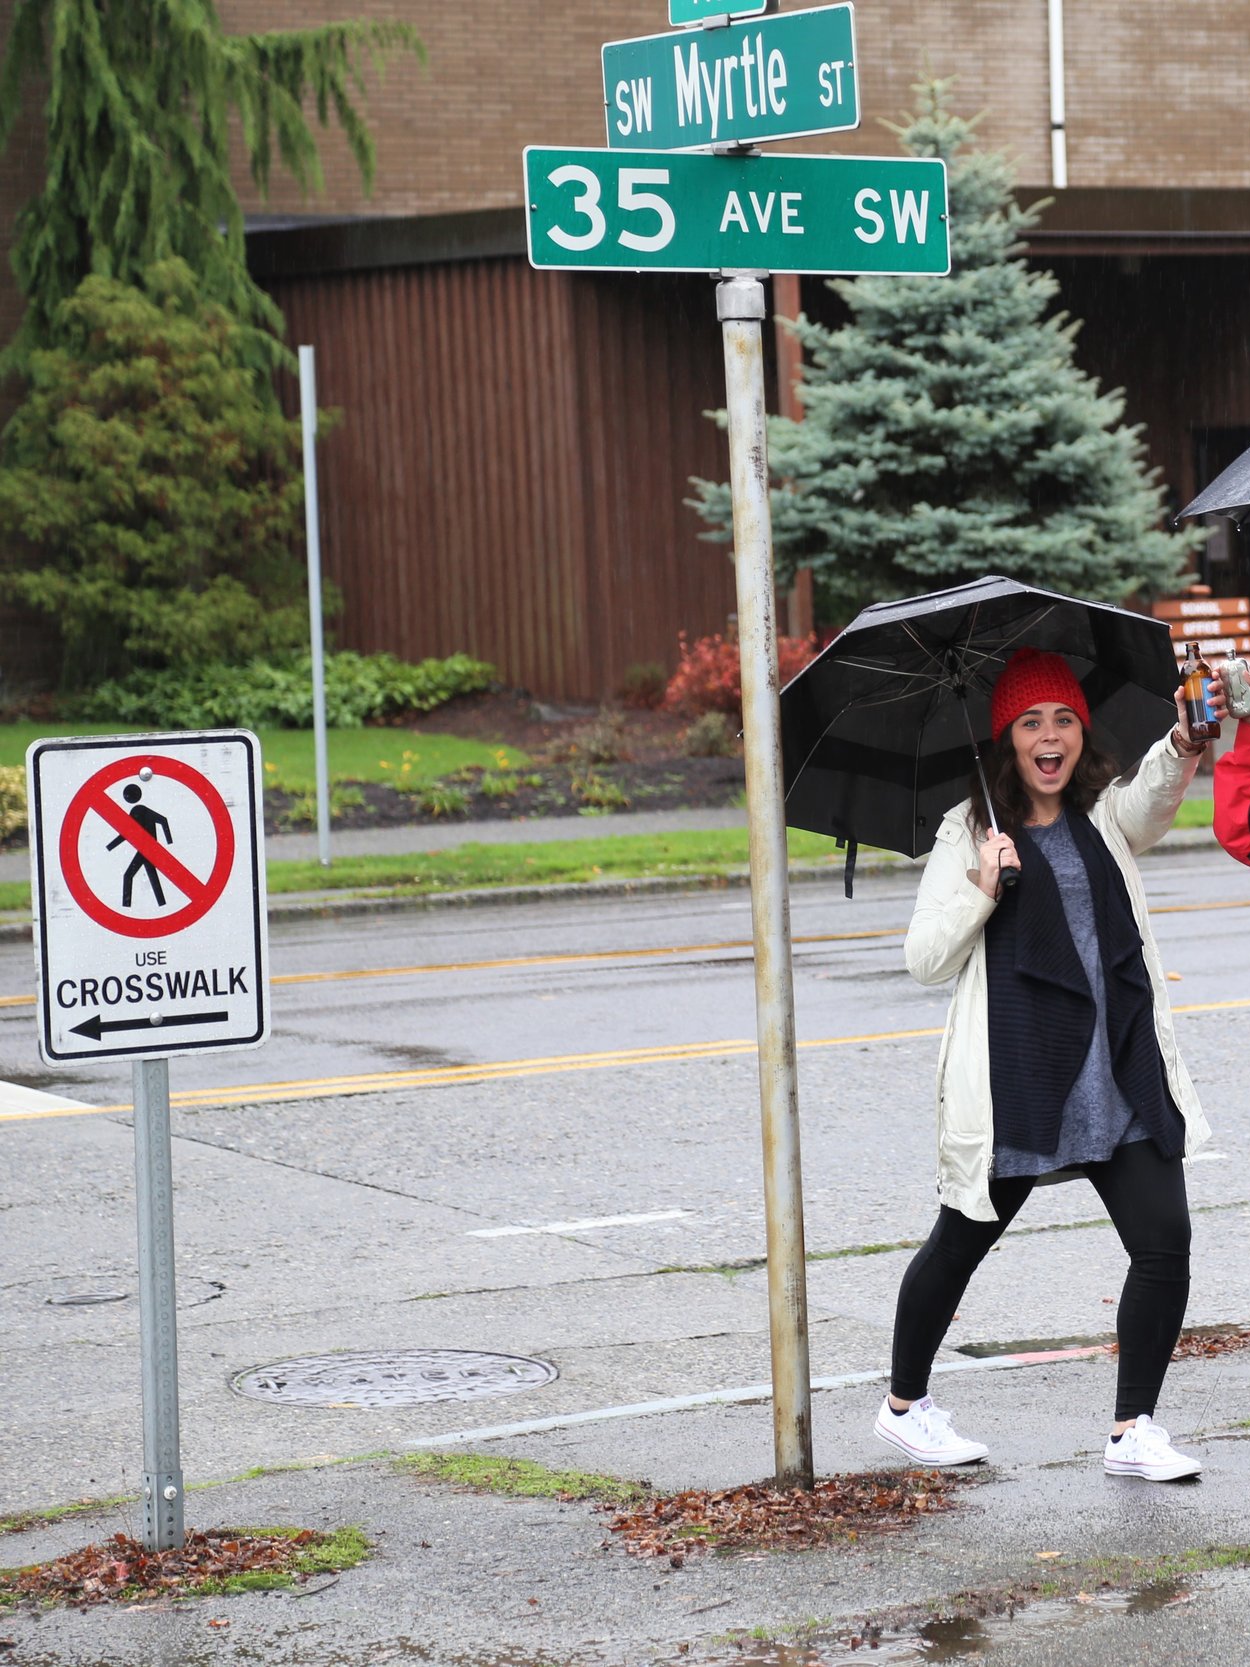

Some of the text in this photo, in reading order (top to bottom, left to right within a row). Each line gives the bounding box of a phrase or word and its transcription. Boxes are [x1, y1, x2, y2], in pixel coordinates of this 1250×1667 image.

[616, 32, 844, 139] SW Myrtle ST
[546, 164, 929, 252] 35 AVE SW
[56, 966, 249, 1009] CROSSWALK
[135, 951, 167, 967] USE
